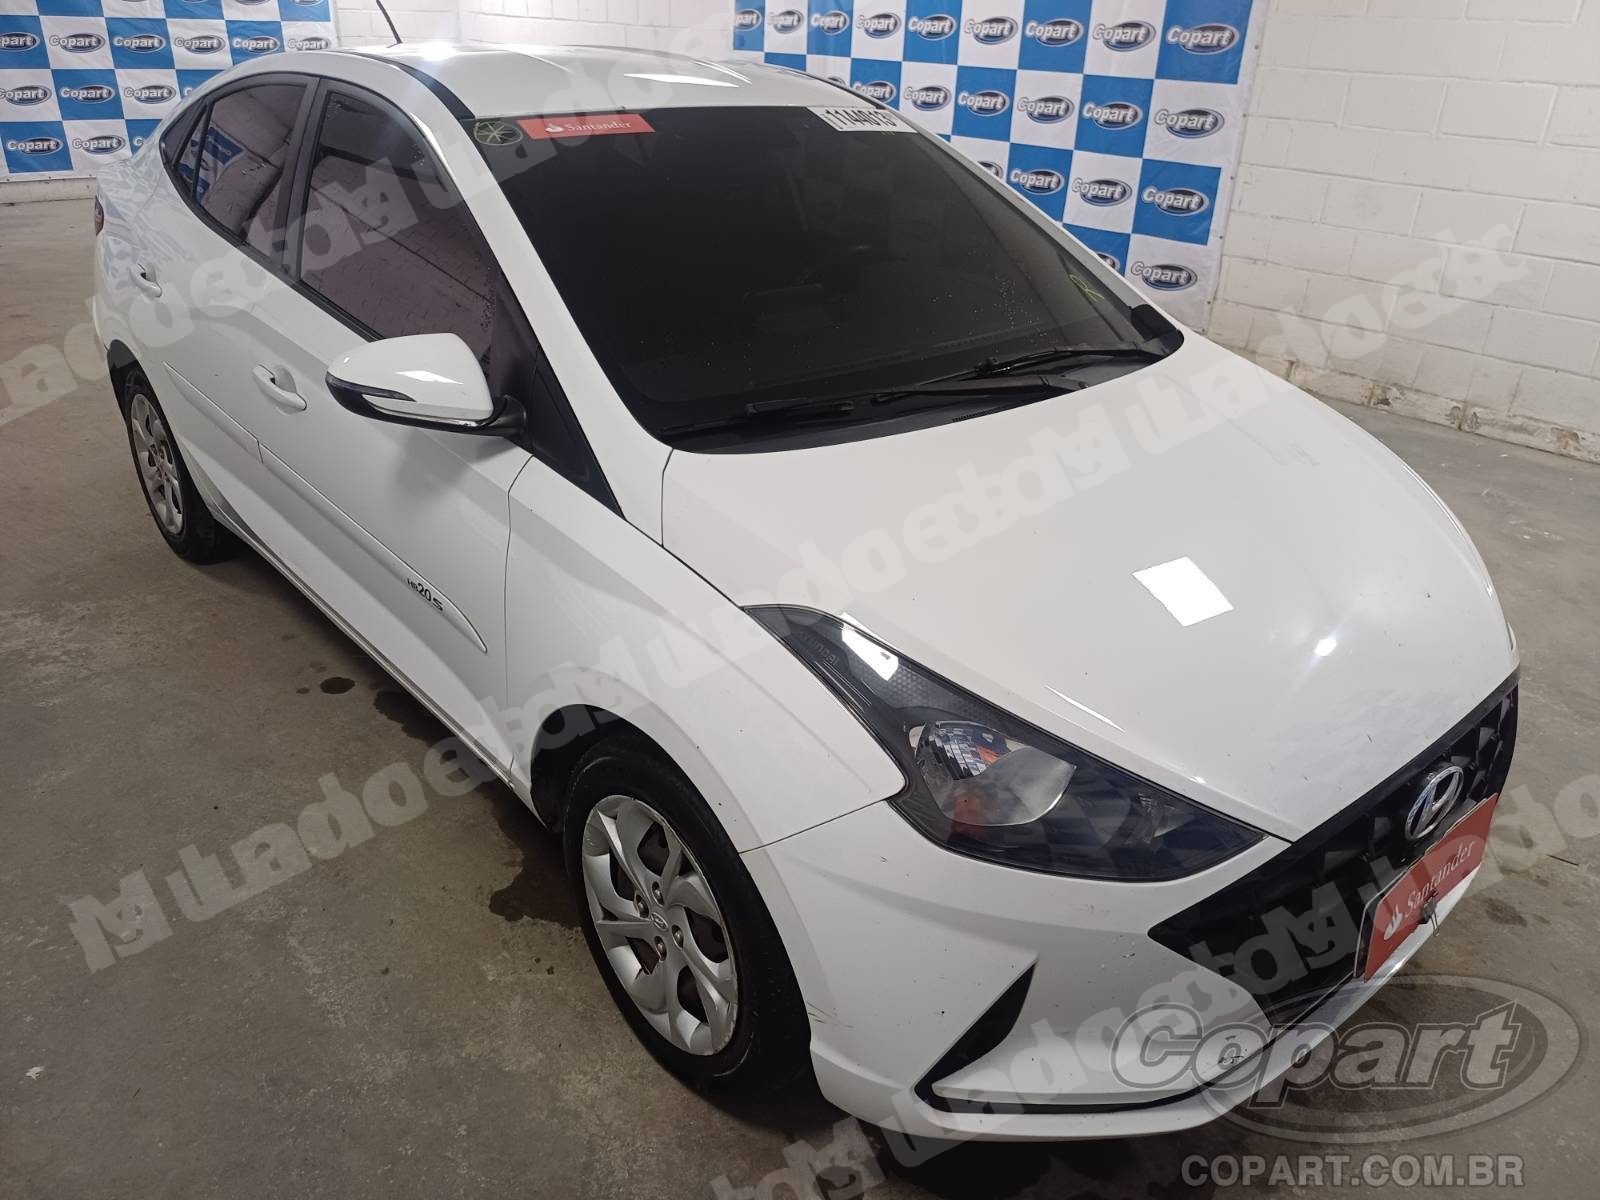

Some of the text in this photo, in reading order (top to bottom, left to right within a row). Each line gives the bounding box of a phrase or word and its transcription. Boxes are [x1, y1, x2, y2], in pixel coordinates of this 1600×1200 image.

[736, 13, 758, 27] part
[811, 12, 845, 29] Copart
[855, 12, 895, 31] Copart
[907, 15, 951, 34] Copart
[964, 18, 1011, 38] Copart
[1025, 20, 1076, 41] Copart
[1092, 23, 1147, 44] Copart
[1166, 26, 1232, 49] Copart
[0, 35, 33, 48] part
[50, 35, 98, 49] Copart
[114, 35, 160, 49] Copart
[174, 36, 219, 49] Copart
[232, 37, 274, 50] Copart
[288, 38, 327, 51] Copart
[60, 87, 109, 100] Copart
[124, 86, 170, 100] Copart
[904, 86, 945, 104] Copart
[957, 89, 1003, 111] Copart
[1016, 95, 1068, 117] Copart
[1082, 102, 1134, 124] Copart
[564, 120, 632, 132] Santander
[824, 109, 897, 127] 1144013
[1154, 108, 1216, 132] Copart
[7, 139, 57, 152] Copart
[72, 137, 118, 150] Copart
[1010, 168, 1058, 189] Copart
[1071, 177, 1123, 200] Copart
[1141, 185, 1200, 211] Copart
[1130, 260, 1188, 285] Copart
[1405, 839, 1476, 917] Santander
